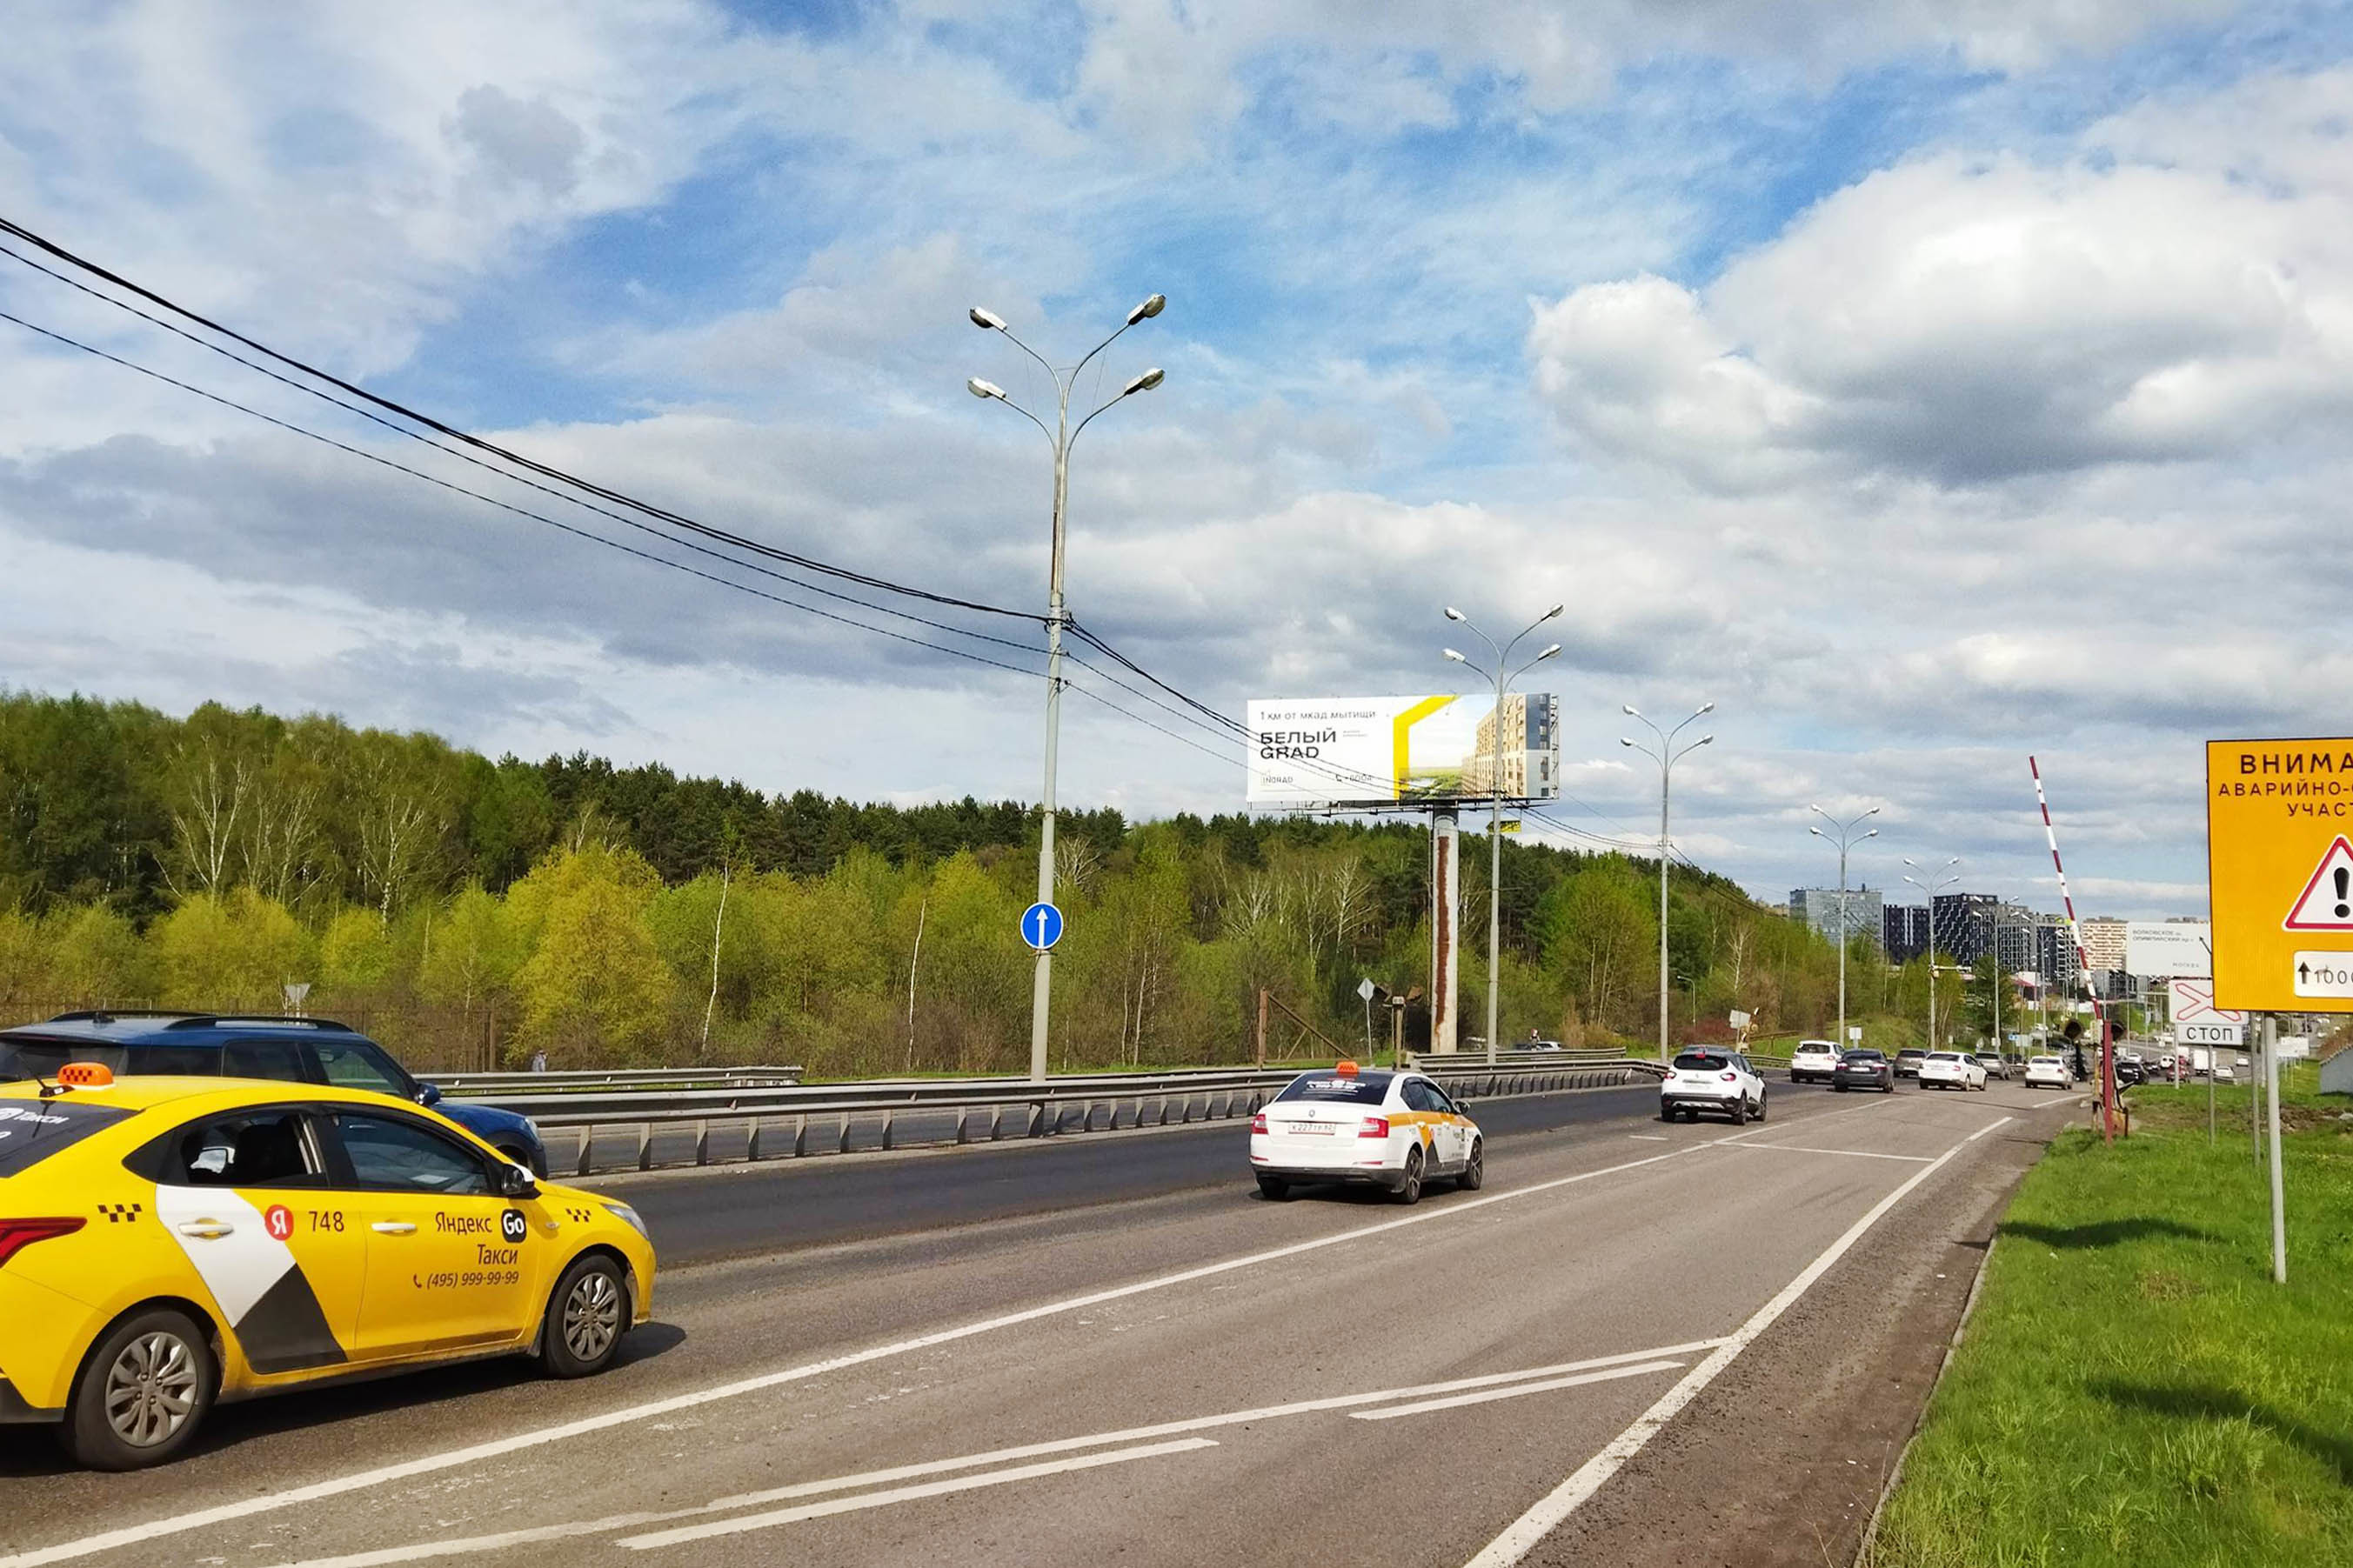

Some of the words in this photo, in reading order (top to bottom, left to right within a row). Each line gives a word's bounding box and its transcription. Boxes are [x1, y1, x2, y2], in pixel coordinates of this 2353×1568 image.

[1260, 727, 1337, 744] БЕЛЫЙ
[1260, 746, 1320, 759] GRAD
[2240, 752, 2353, 774] ВНИМА
[2218, 778, 2353, 797] АВАРИЙНО-
[2314, 970, 2353, 984] 100
[2186, 1026, 2234, 1041] СТОП
[271, 1210, 288, 1235] Я
[309, 1211, 345, 1232] 748
[435, 1211, 493, 1235] Яндекс
[502, 1212, 525, 1236] Go
[477, 1244, 519, 1265] Такси
[427, 1272, 458, 1290] (495)
[461, 1271, 520, 1286] 999-99-99
